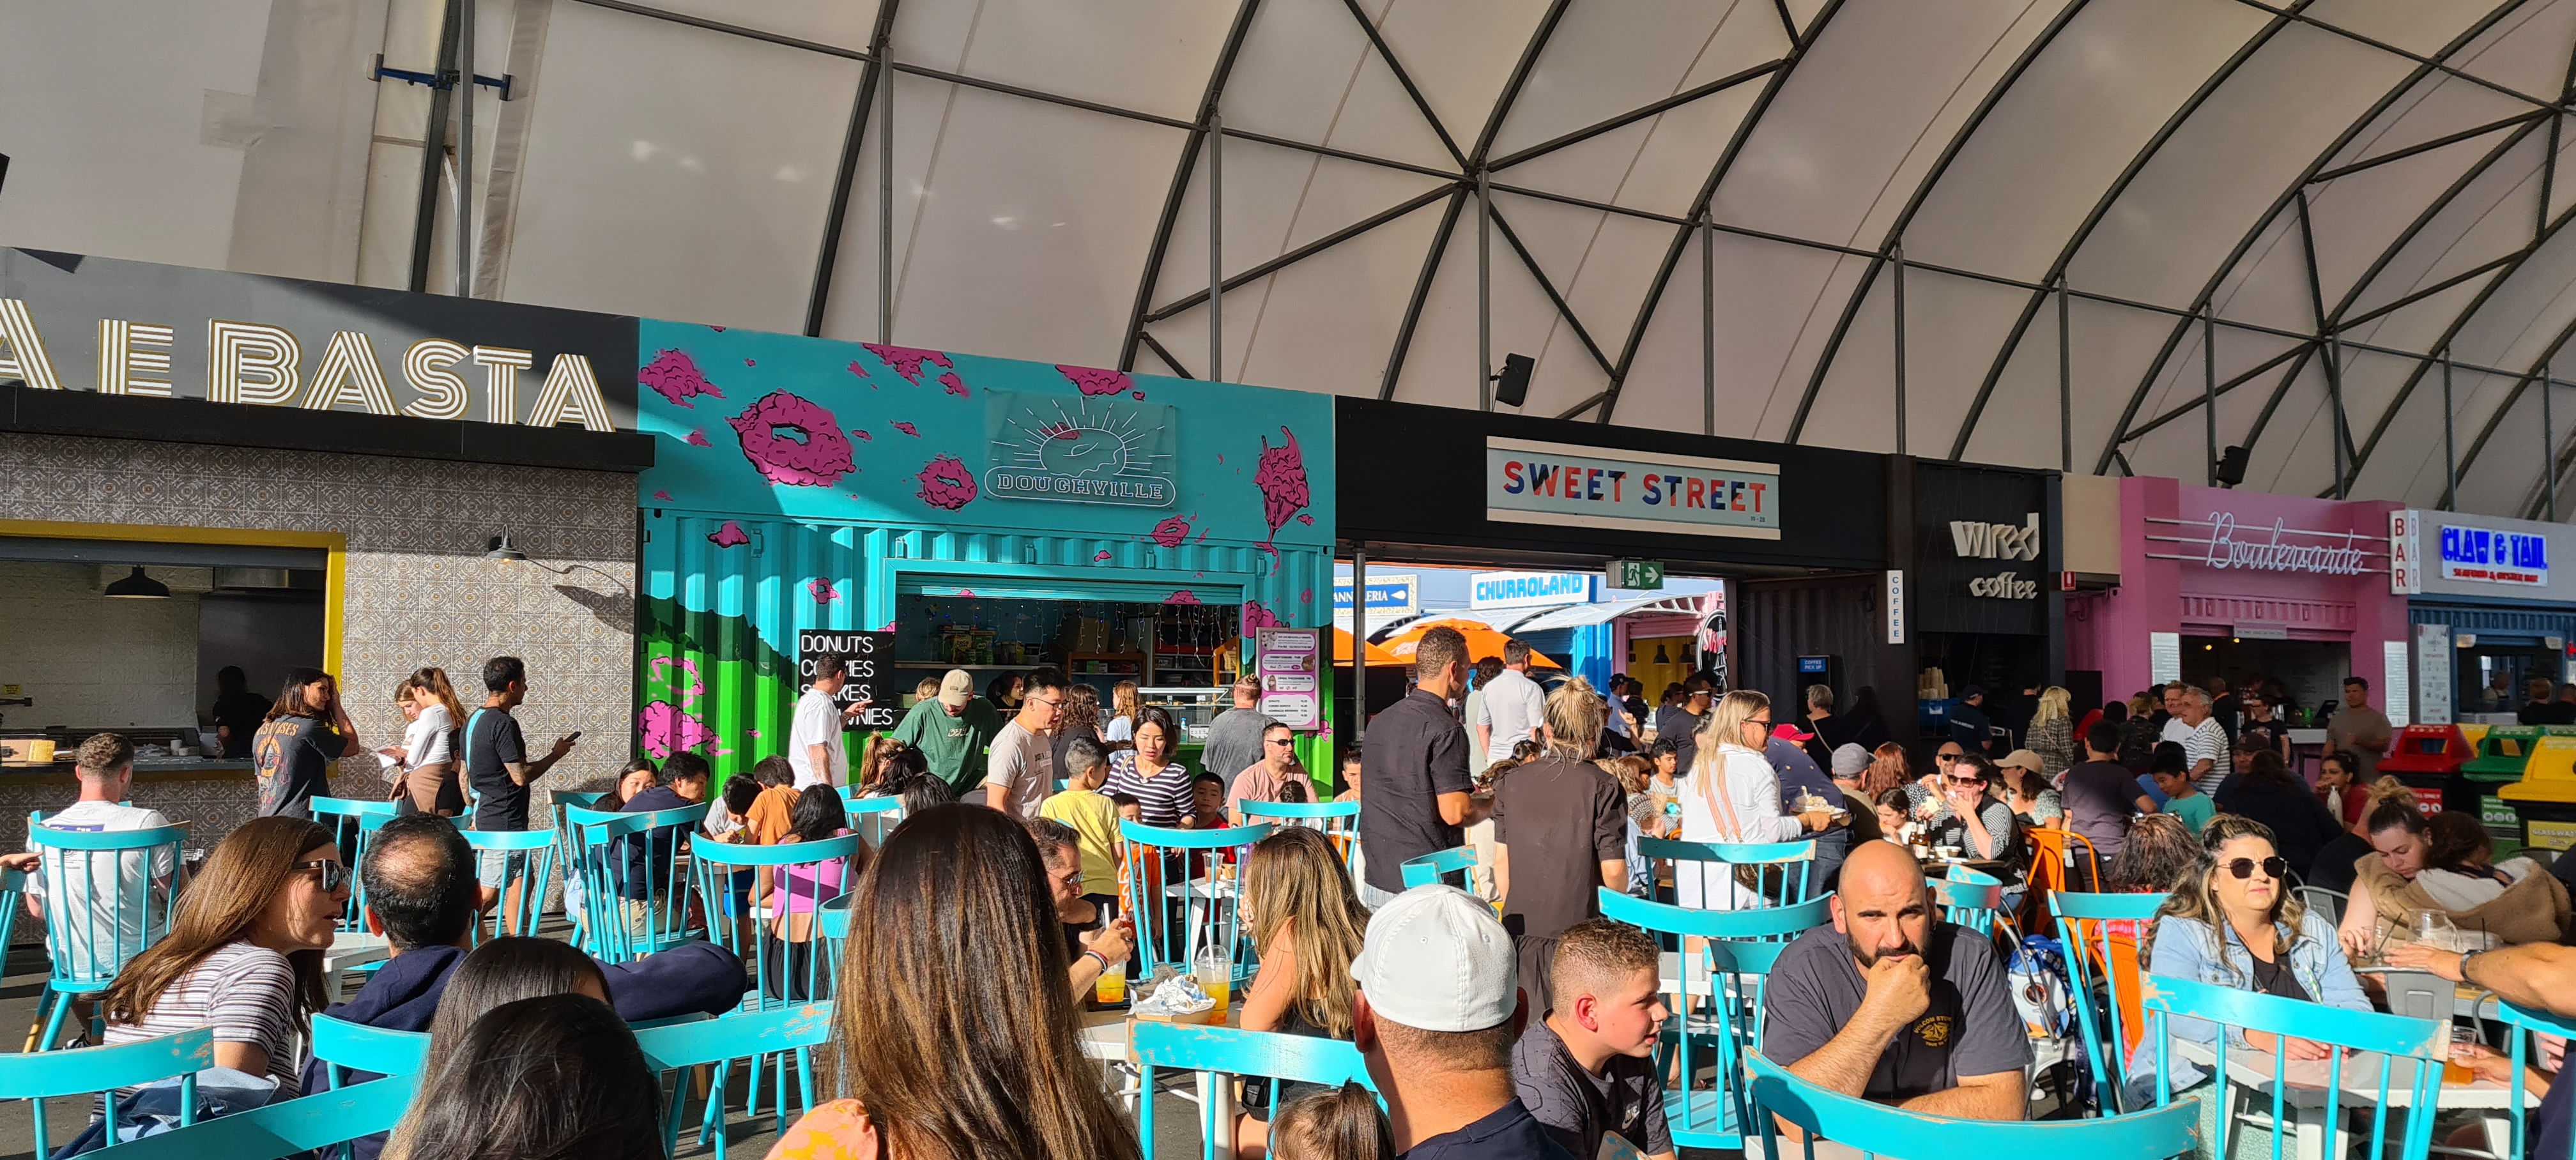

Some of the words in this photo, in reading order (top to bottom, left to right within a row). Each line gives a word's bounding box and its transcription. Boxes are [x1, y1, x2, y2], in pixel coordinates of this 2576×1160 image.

[97, 318, 174, 397] E
[206, 317, 617, 432] BASTA
[997, 473, 1163, 499] DOUGHVILLE
[1503, 461, 1627, 503] SWEET
[1642, 473, 1767, 513] STREET
[2206, 511, 2364, 575] Boulevarde
[2395, 518, 2407, 587] BAR
[2411, 518, 2419, 587] BAR
[2441, 527, 2490, 564] CLAW
[2510, 534, 2548, 570] TAIL
[1333, 589, 1388, 602] ANNERIA
[1476, 574, 1583, 601] CHURROLAND
[1969, 572, 2037, 599] coffee
[801, 635, 874, 653] DONUTS
[801, 659, 875, 678] CIES
[1913, 1016, 1936, 1033] VOLCOM
